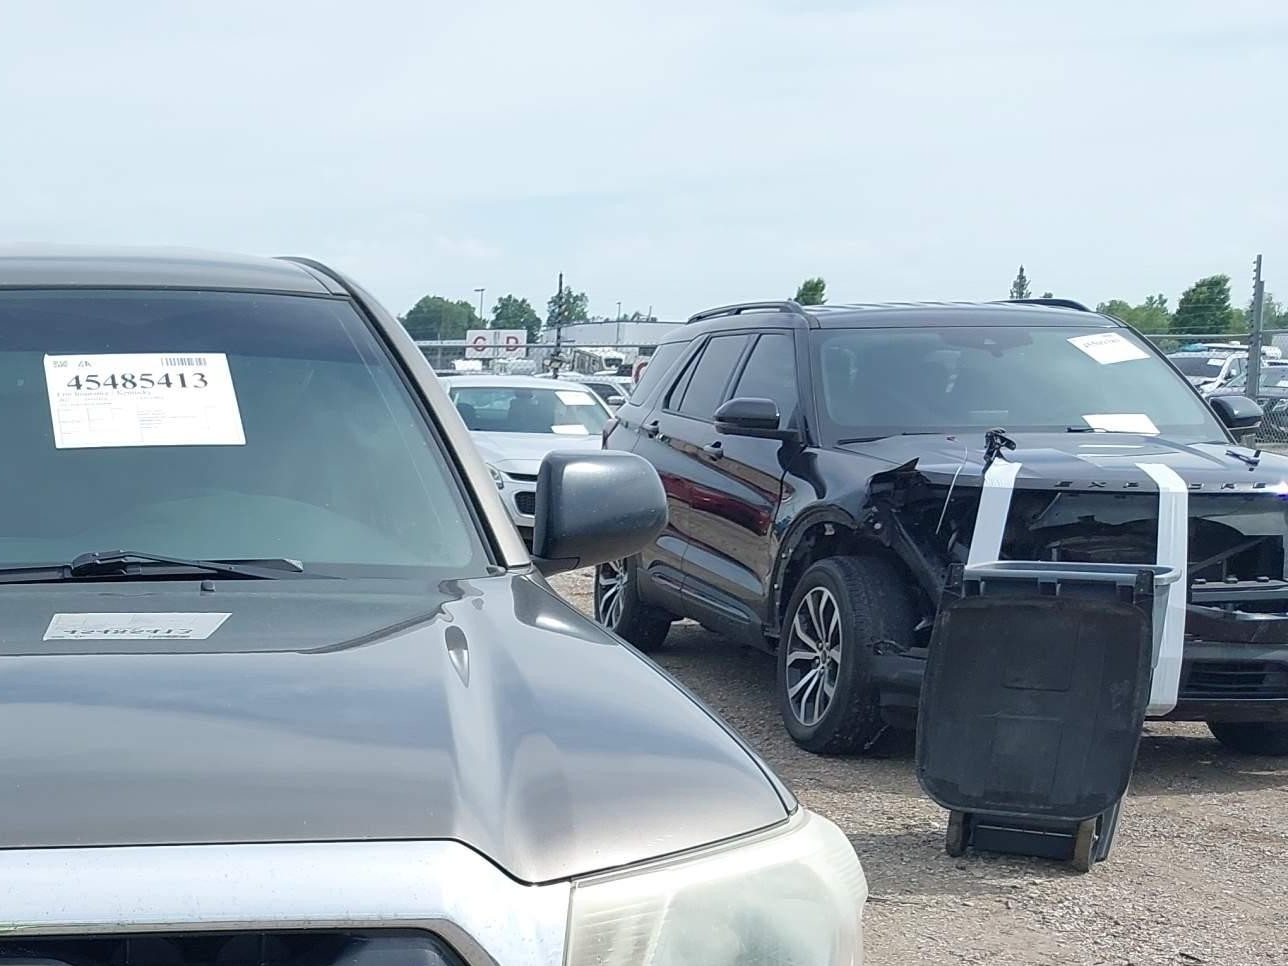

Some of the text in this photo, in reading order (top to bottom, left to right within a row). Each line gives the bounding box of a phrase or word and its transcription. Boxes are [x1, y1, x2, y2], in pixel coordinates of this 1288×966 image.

[472, 336, 487, 352] C
[506, 336, 520, 352] D
[66, 372, 209, 391] 45485413
